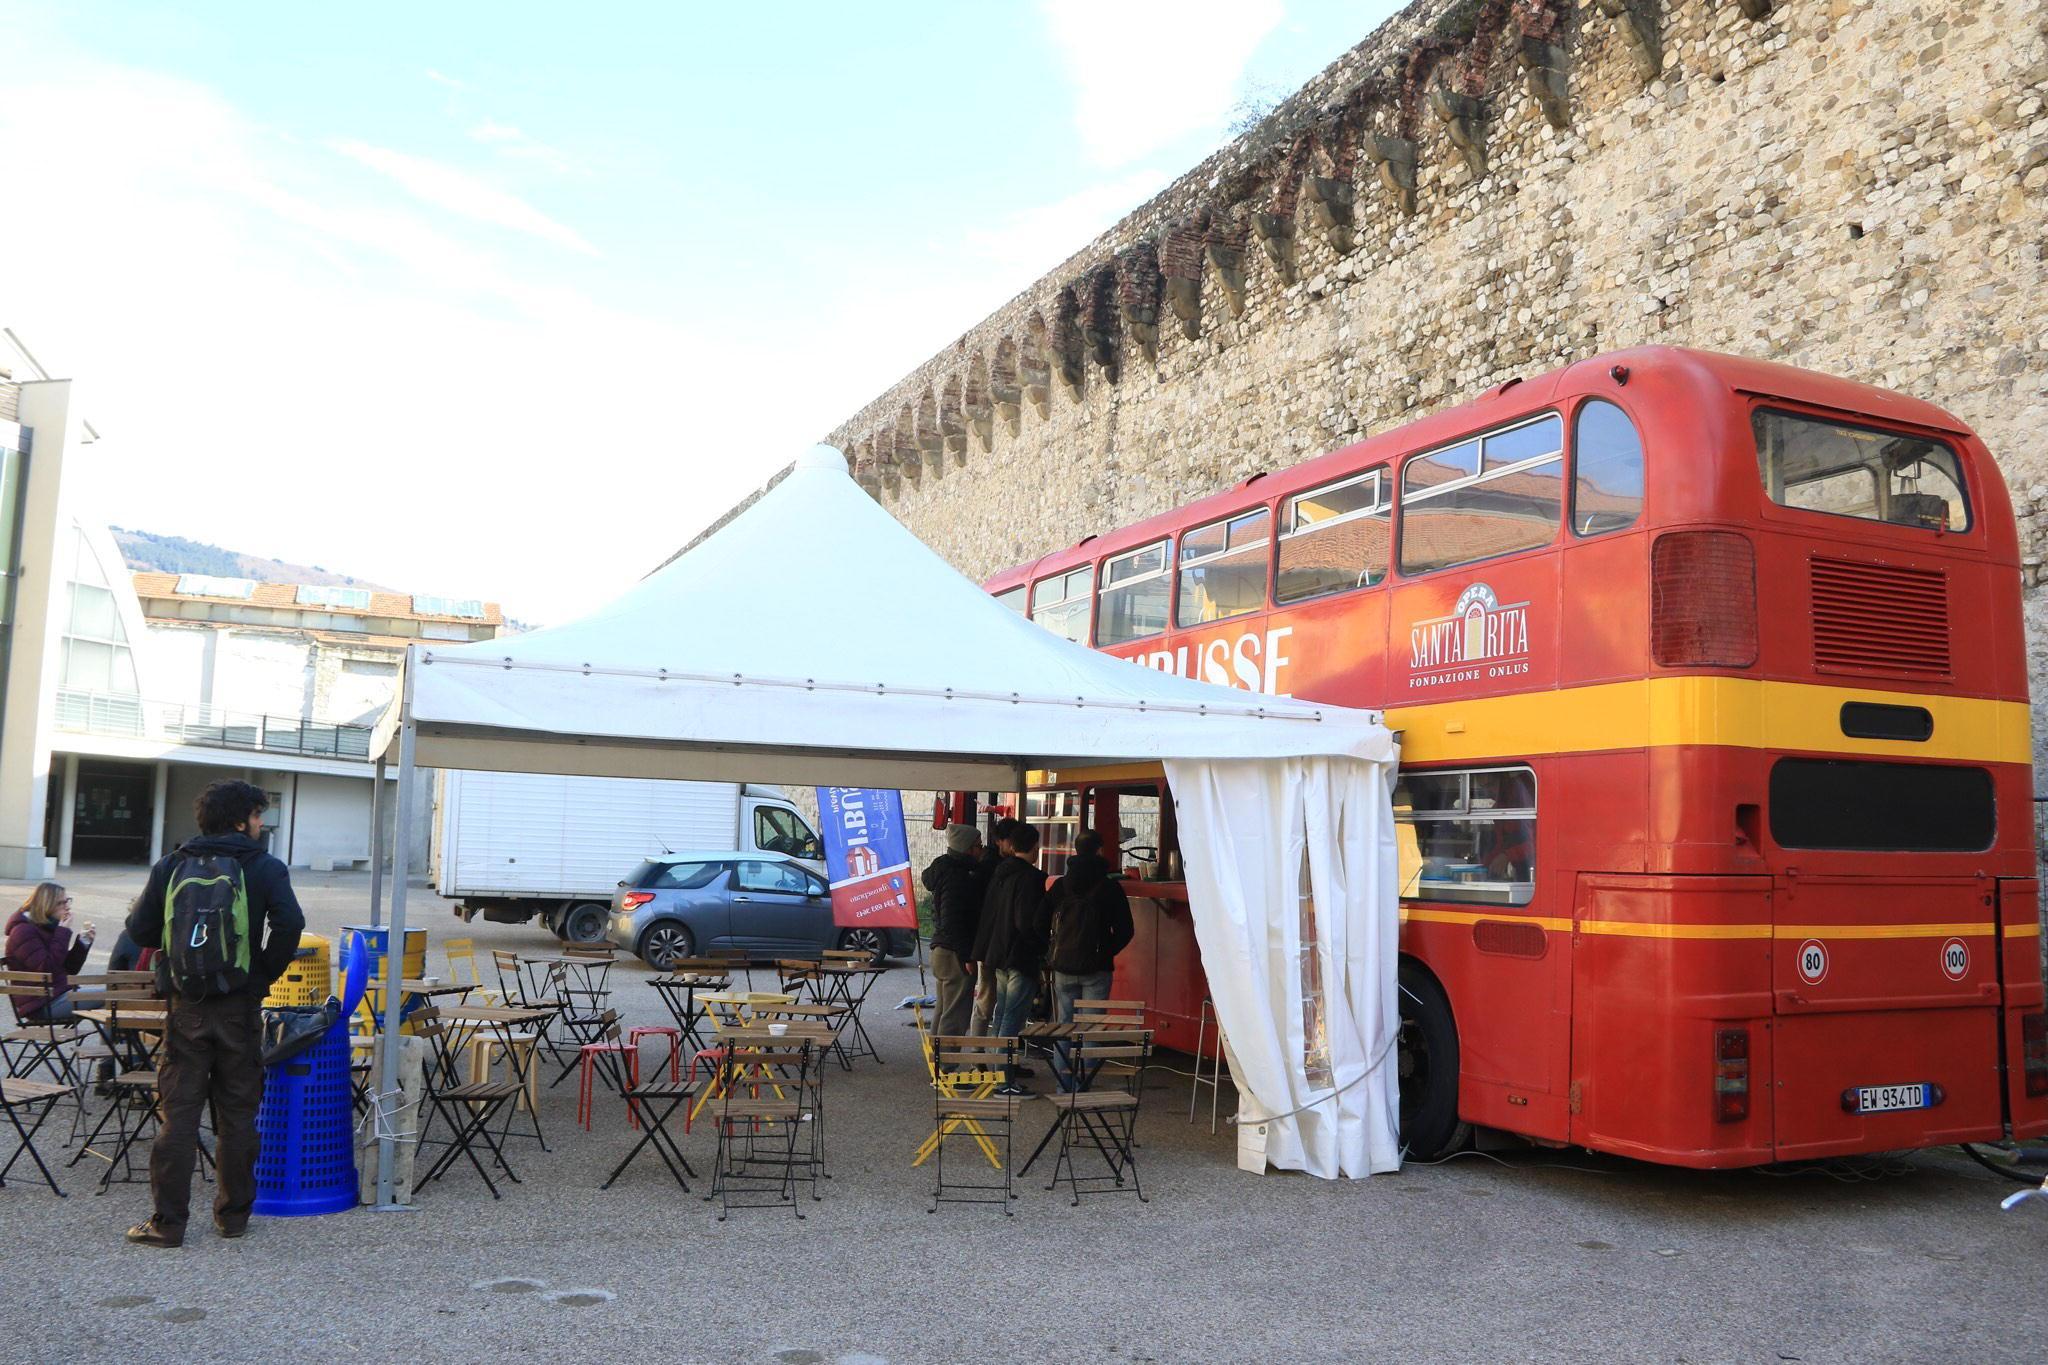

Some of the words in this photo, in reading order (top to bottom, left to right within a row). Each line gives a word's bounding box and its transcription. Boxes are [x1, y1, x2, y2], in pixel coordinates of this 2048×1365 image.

[1458, 586, 1494, 613] OPERA
[1410, 620, 1462, 668] SANTA
[1486, 608, 1528, 658] RITA
[1409, 669, 1480, 688] FONDAZIONE
[1489, 662, 1529, 678] ONLUS
[1806, 953, 1820, 970] 80
[1946, 951, 1965, 968] 100
